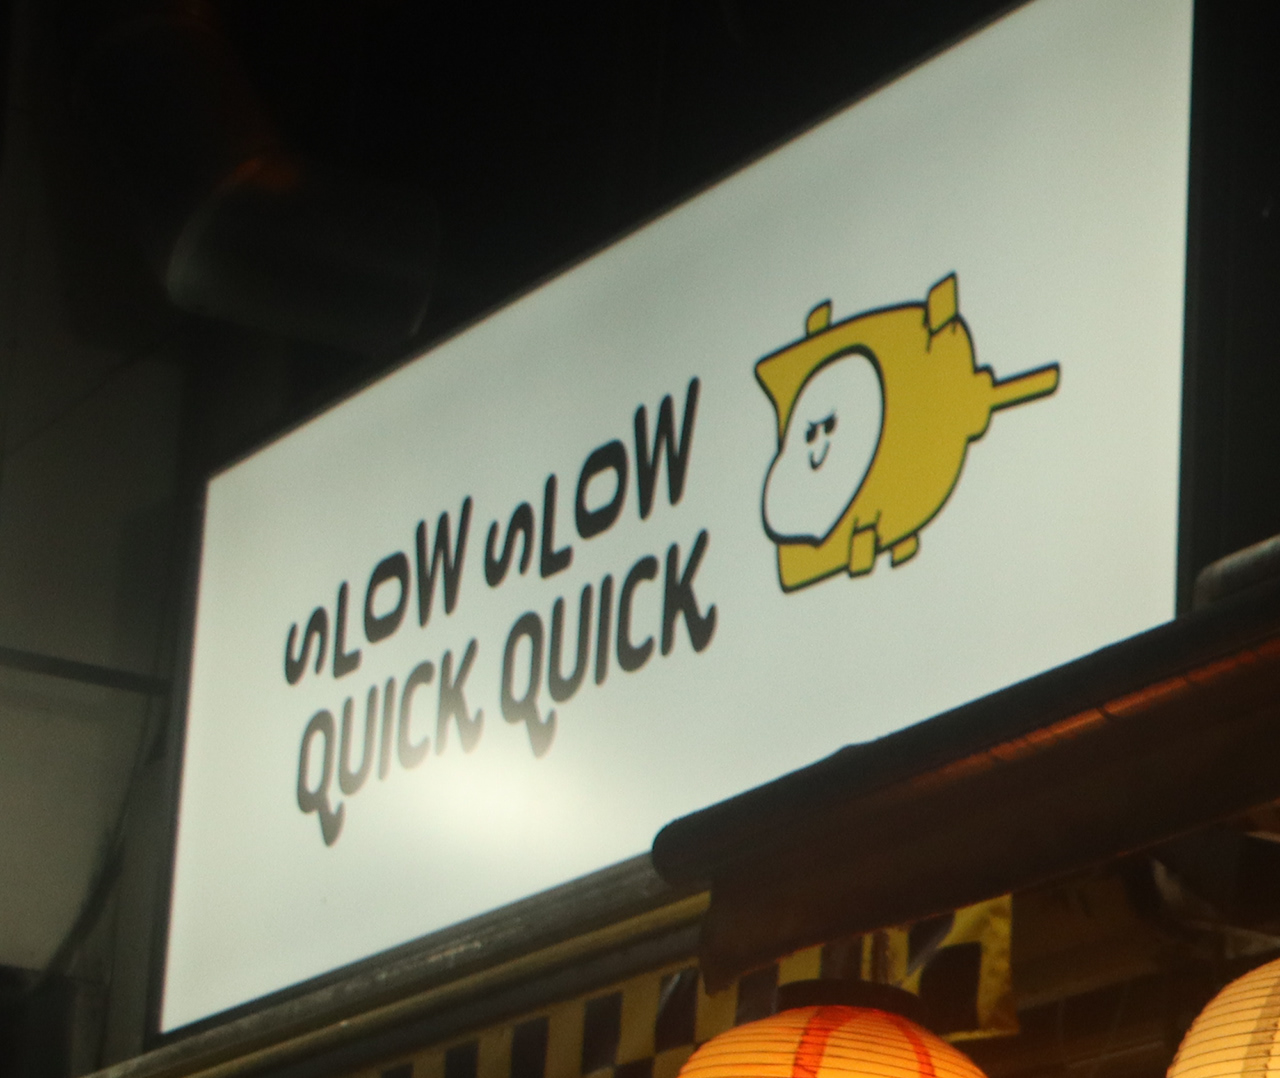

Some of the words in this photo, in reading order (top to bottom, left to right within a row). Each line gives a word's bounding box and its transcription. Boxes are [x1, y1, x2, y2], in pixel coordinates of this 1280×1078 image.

[284, 496, 472, 685] SLOW
[483, 376, 700, 588] SLOW
[296, 638, 484, 847] QUICK
[500, 529, 717, 758] QUICK
